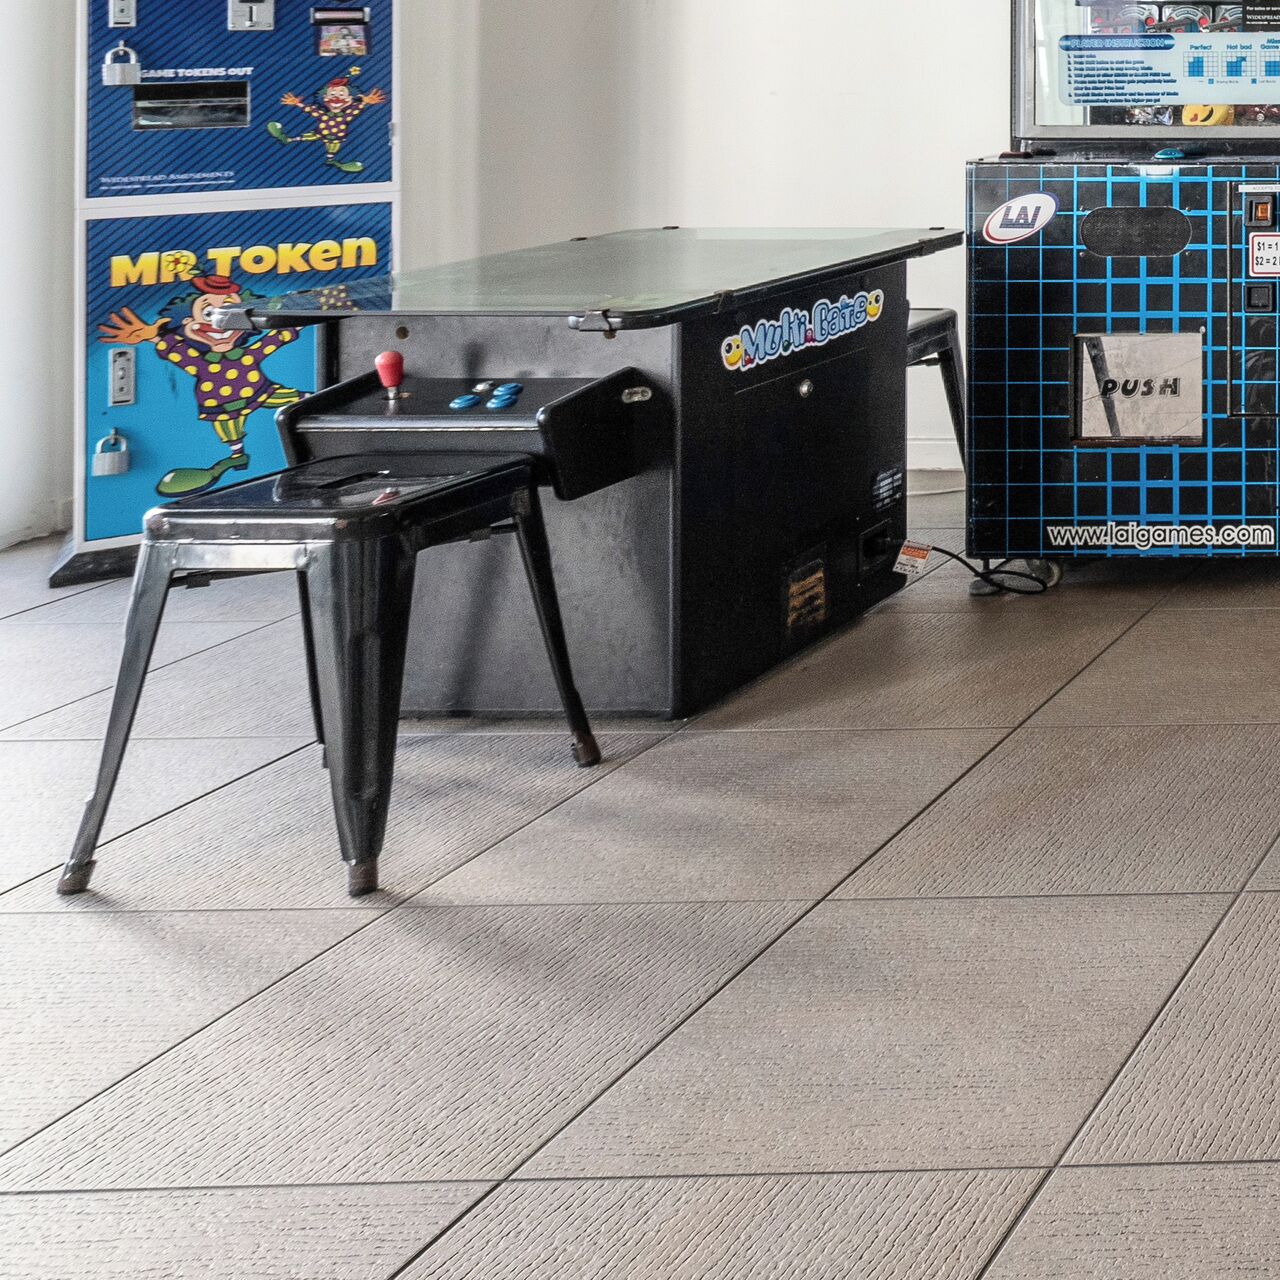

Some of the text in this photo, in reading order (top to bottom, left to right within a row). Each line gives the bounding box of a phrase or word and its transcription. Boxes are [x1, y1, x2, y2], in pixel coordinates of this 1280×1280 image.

[1239, 43, 1252, 51] bad
[141, 67, 254, 78] GAME TOKENS OUT
[998, 204, 1043, 230] LAI
[1257, 241, 1265, 252] $1
[1274, 241, 1279, 251] 1
[109, 249, 199, 289] MR
[1255, 256, 1264, 266] $2
[1272, 256, 1277, 266] 2
[740, 309, 808, 369] Multi
[1100, 376, 1181, 401] PUSH
[1046, 521, 1276, 551] www.laigames.com
